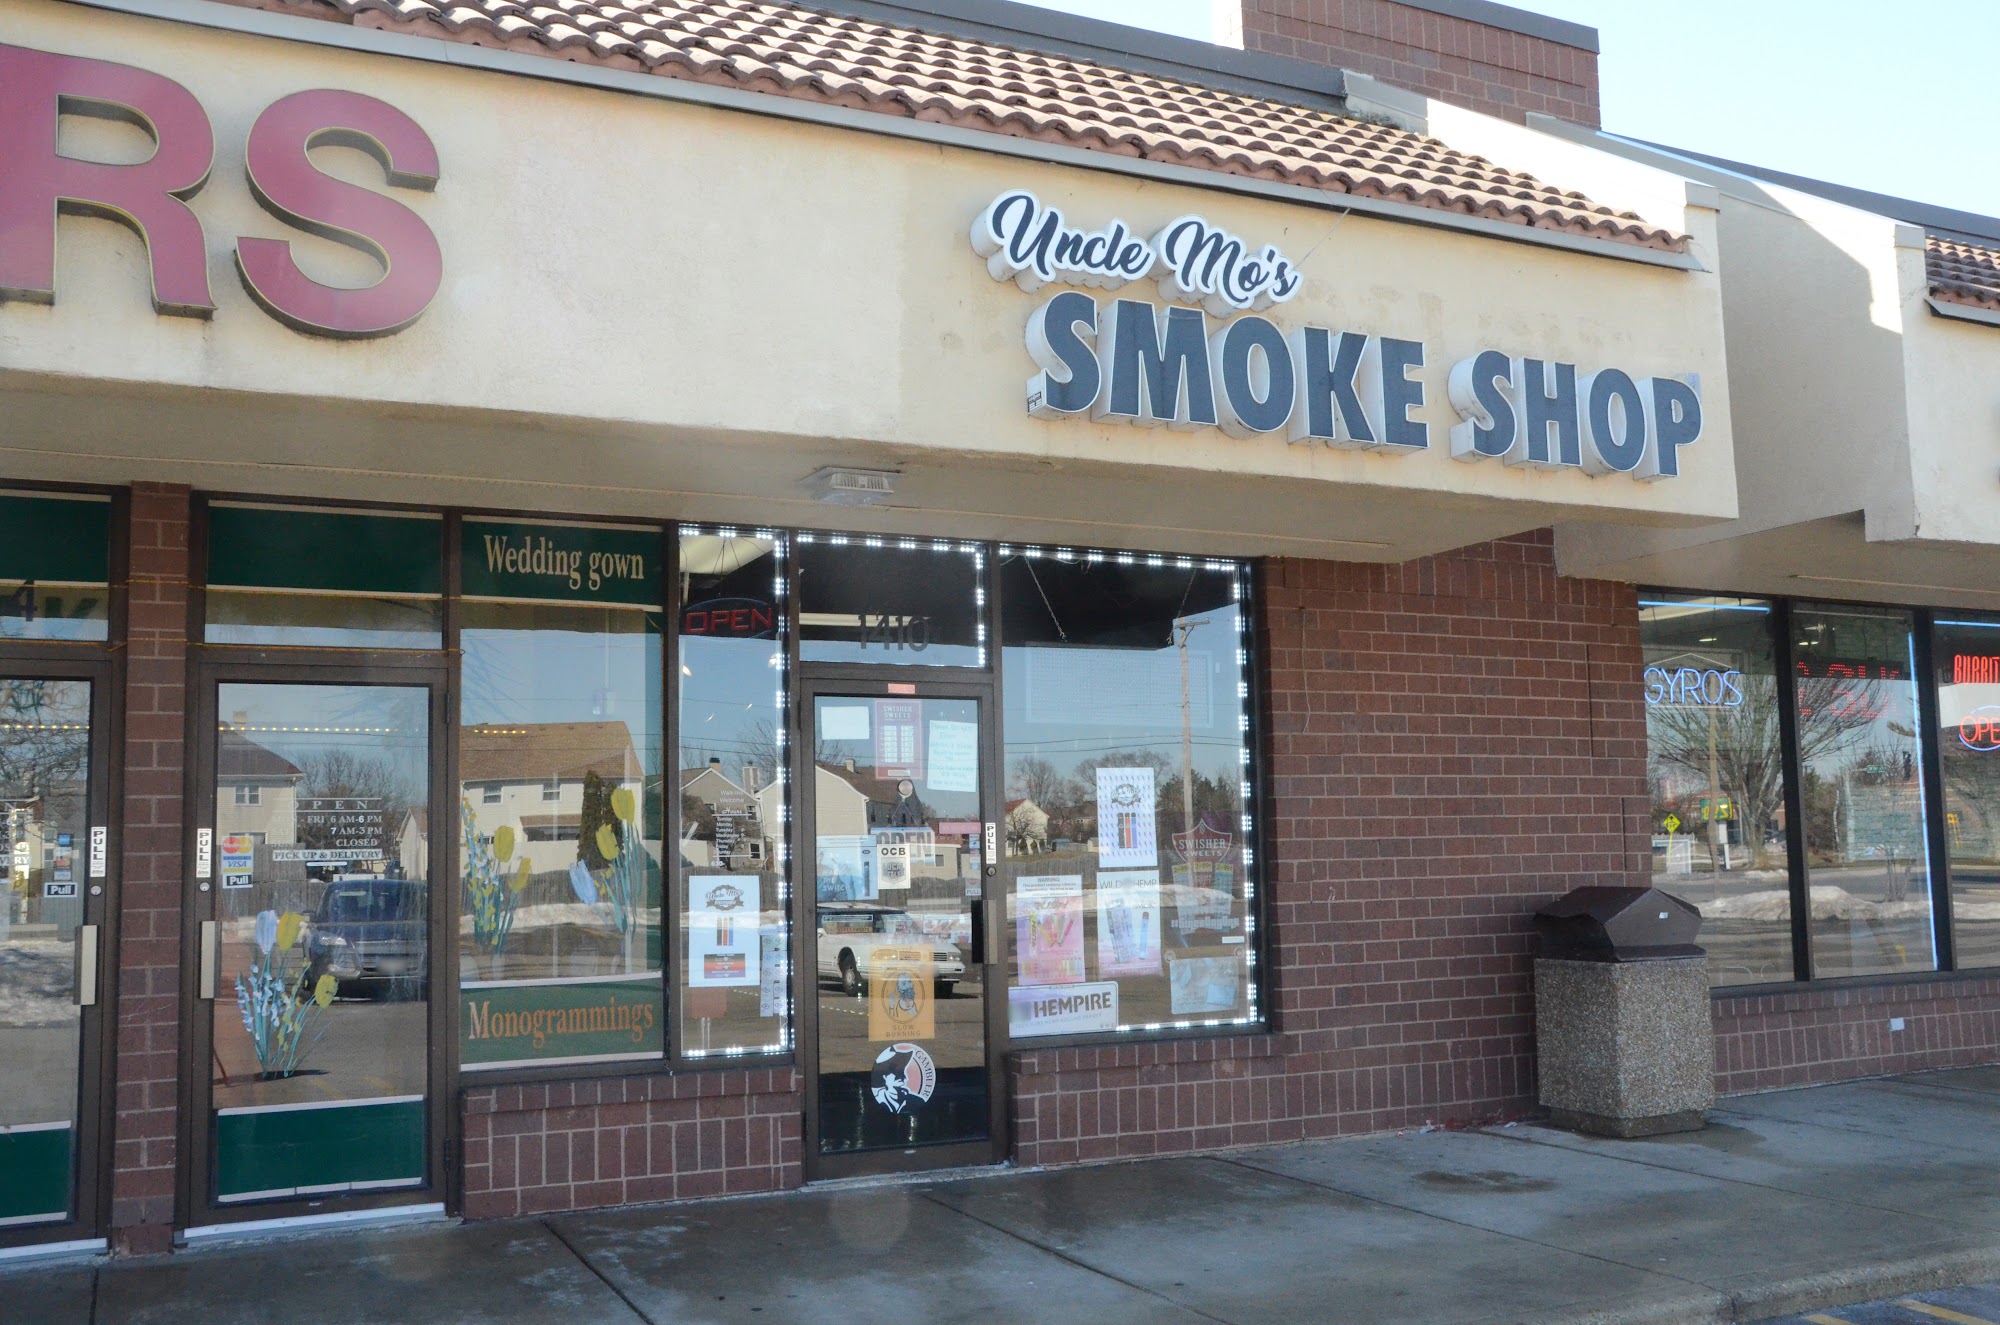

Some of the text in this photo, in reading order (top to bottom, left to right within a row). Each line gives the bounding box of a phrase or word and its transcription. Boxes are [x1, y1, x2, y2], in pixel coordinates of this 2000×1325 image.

[990, 193, 1299, 304] Uncle Mo's
[1040, 290, 1701, 477] SMOKE SHOP
[484, 534, 645, 591] Wedding gown
[685, 607, 773, 634] OPEN
[857, 612, 930, 652] 1410
[1643, 667, 1744, 706] GYROS
[307, 815, 325, 823] FRI
[367, 815, 382, 823] PM
[93, 831, 104, 860] PULL
[199, 832, 210, 861] PULL
[336, 839, 378, 847] CLOSED
[881, 847, 906, 855] OCB
[986, 826, 995, 850] PULL
[1178, 838, 1227, 850] SWISHER
[274, 852, 299, 860] PICK
[303, 851, 317, 859] UP
[331, 851, 380, 859] DELIVERY
[50, 885, 72, 895] Pull
[229, 875, 248, 885] Pull
[1100, 880, 1121, 889] WILD
[1033, 991, 1112, 1018] HEMPIRE
[468, 996, 655, 1050] Monogrammings
[915, 1050, 934, 1101] GAMBLER
